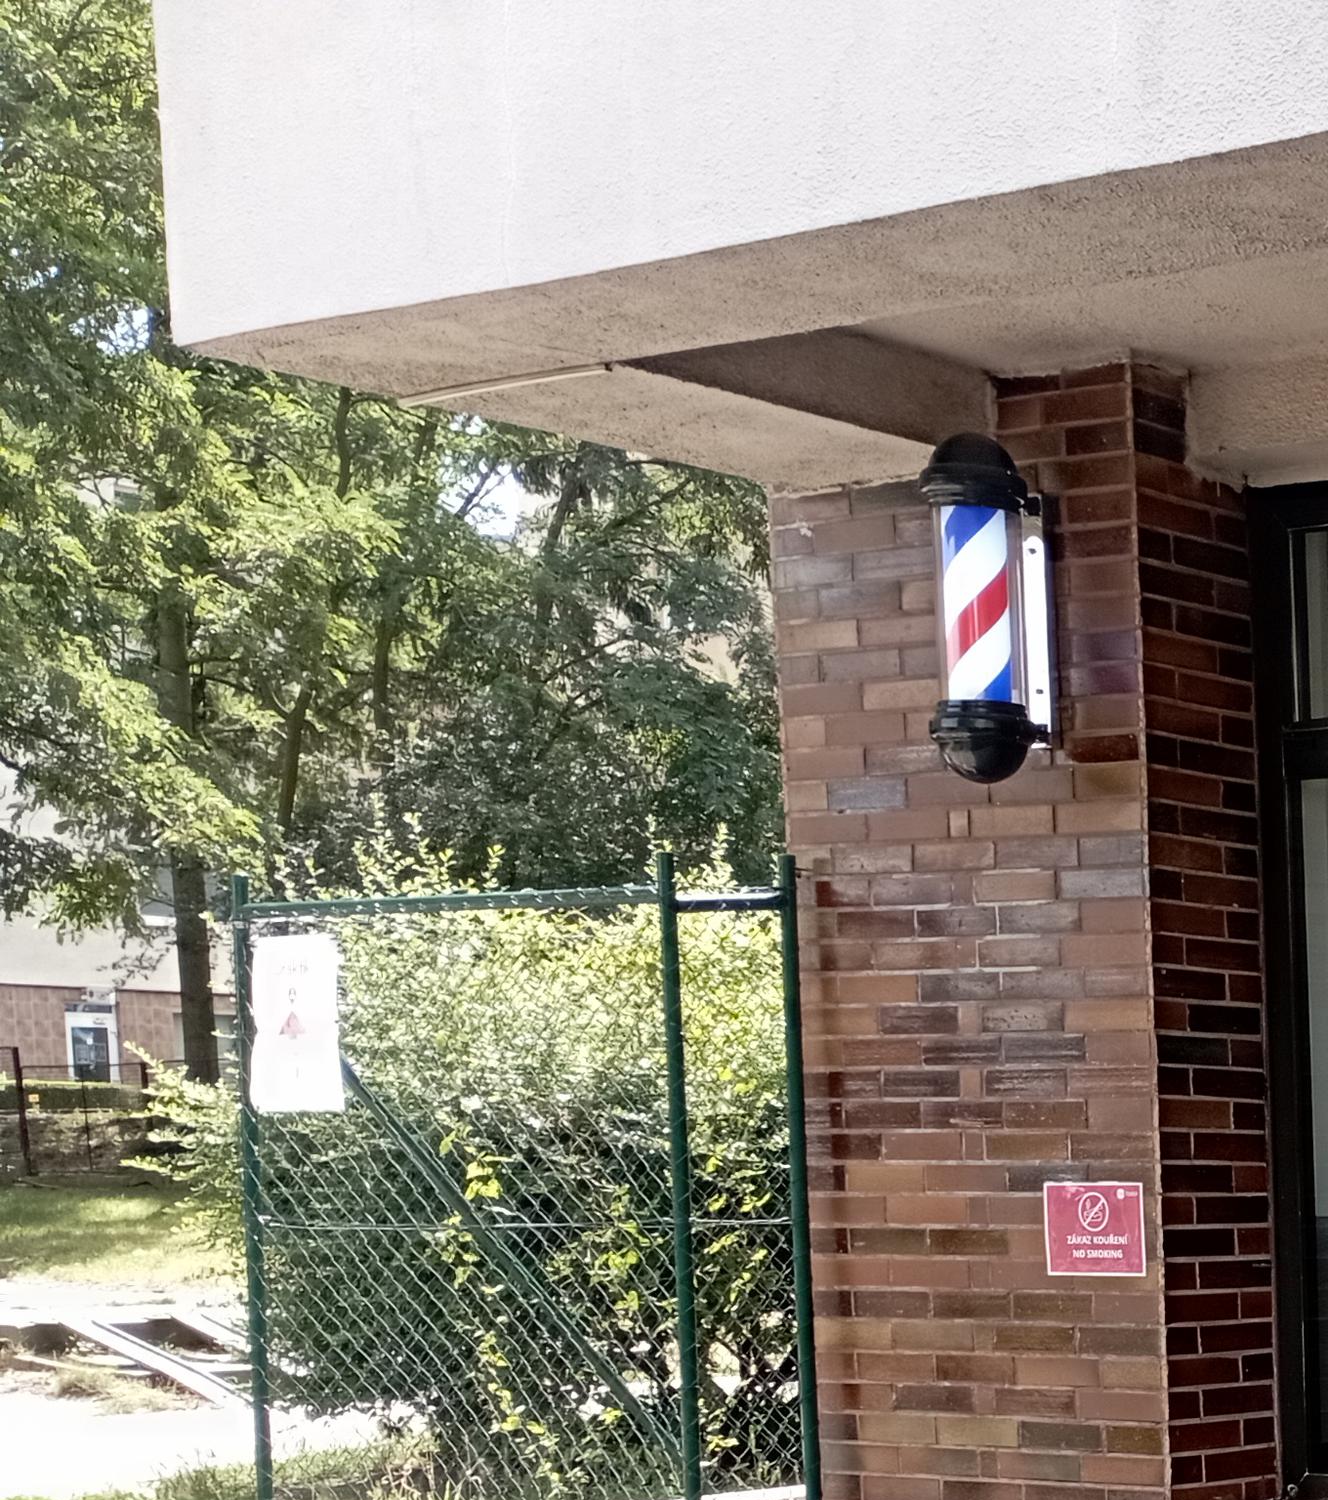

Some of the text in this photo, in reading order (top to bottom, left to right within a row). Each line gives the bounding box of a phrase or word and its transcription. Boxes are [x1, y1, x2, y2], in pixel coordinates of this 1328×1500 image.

[1067, 1233, 1129, 1245] ZÁKAZ KOUŘENÍ
[1073, 1250, 1124, 1259] NO SMOKING
